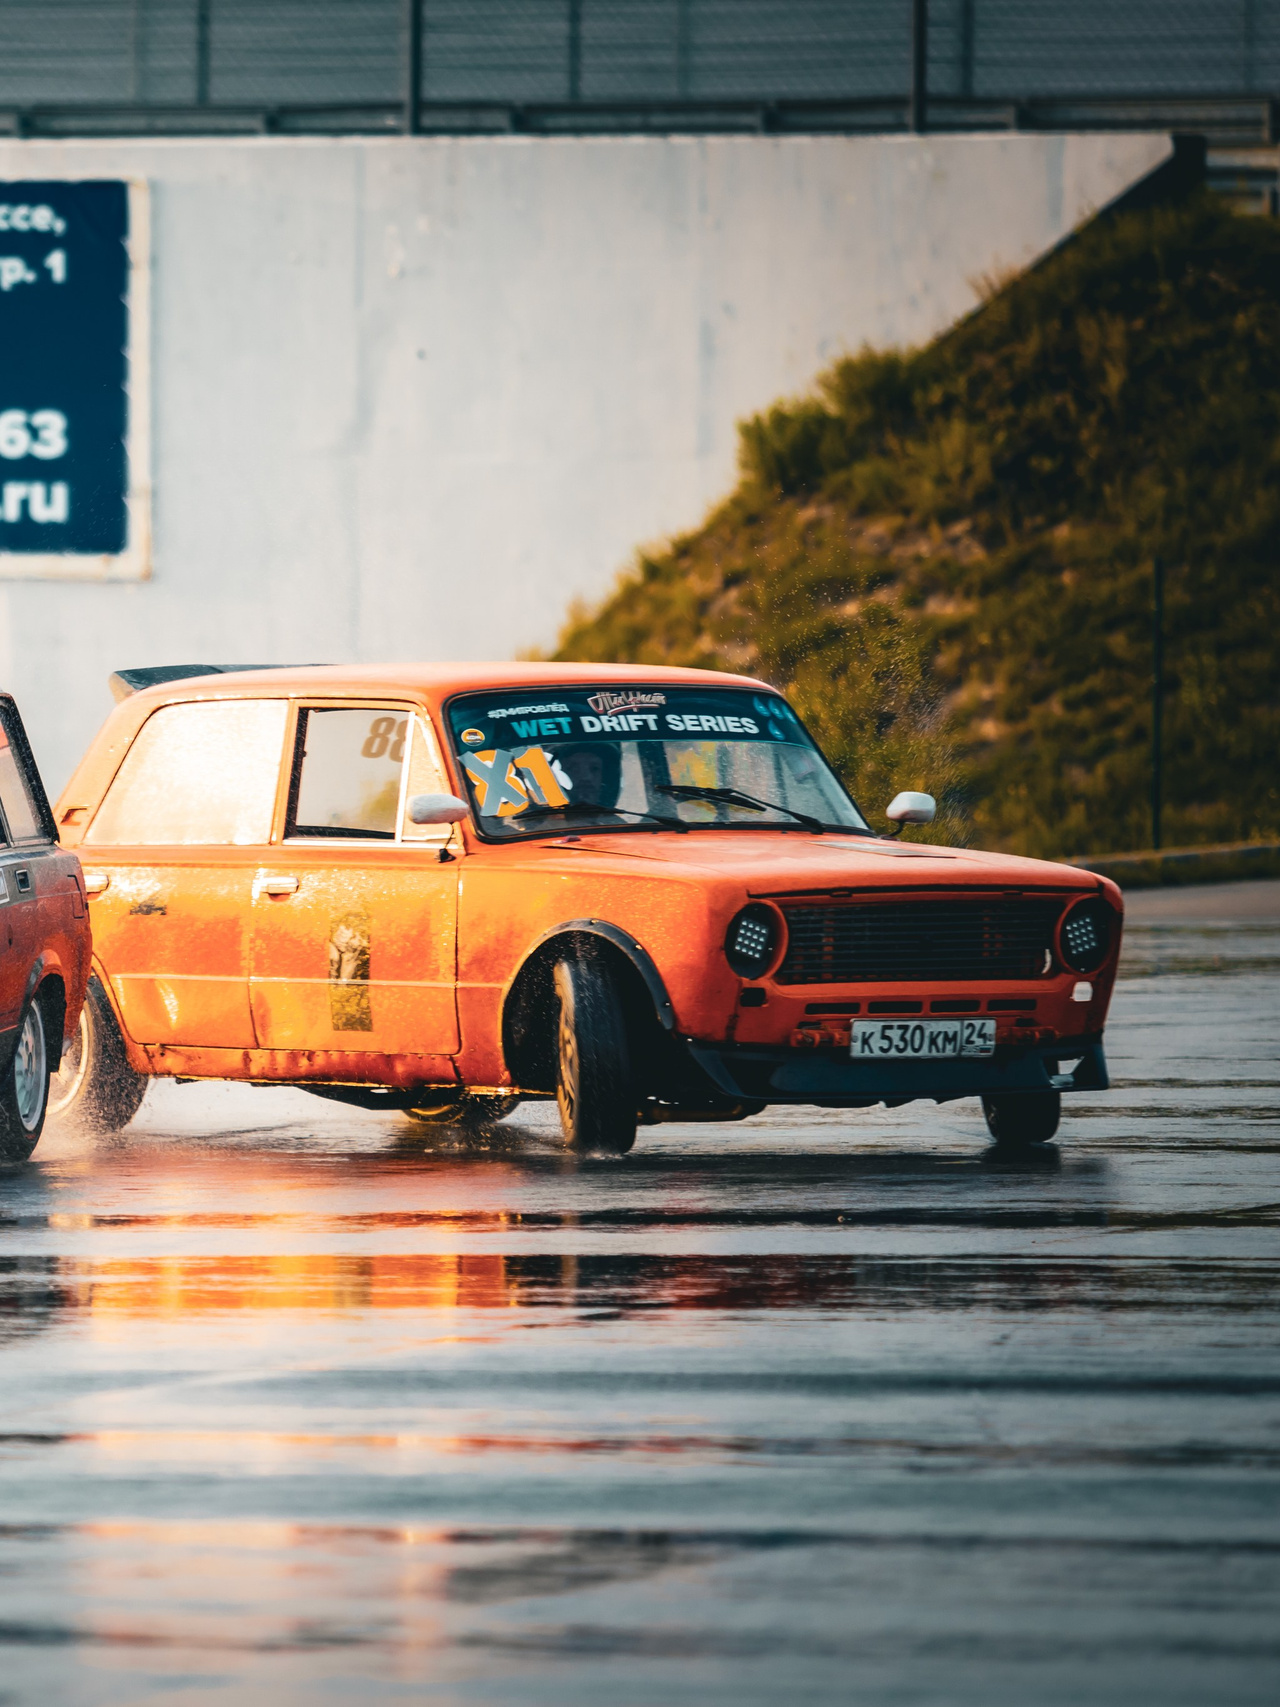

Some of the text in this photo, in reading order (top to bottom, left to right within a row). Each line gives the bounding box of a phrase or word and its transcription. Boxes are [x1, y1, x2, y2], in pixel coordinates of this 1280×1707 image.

[44, 249, 67, 284] 1
[510, 714, 759, 738] WET DRIFT SERIES
[965, 1022, 987, 1045] 24
